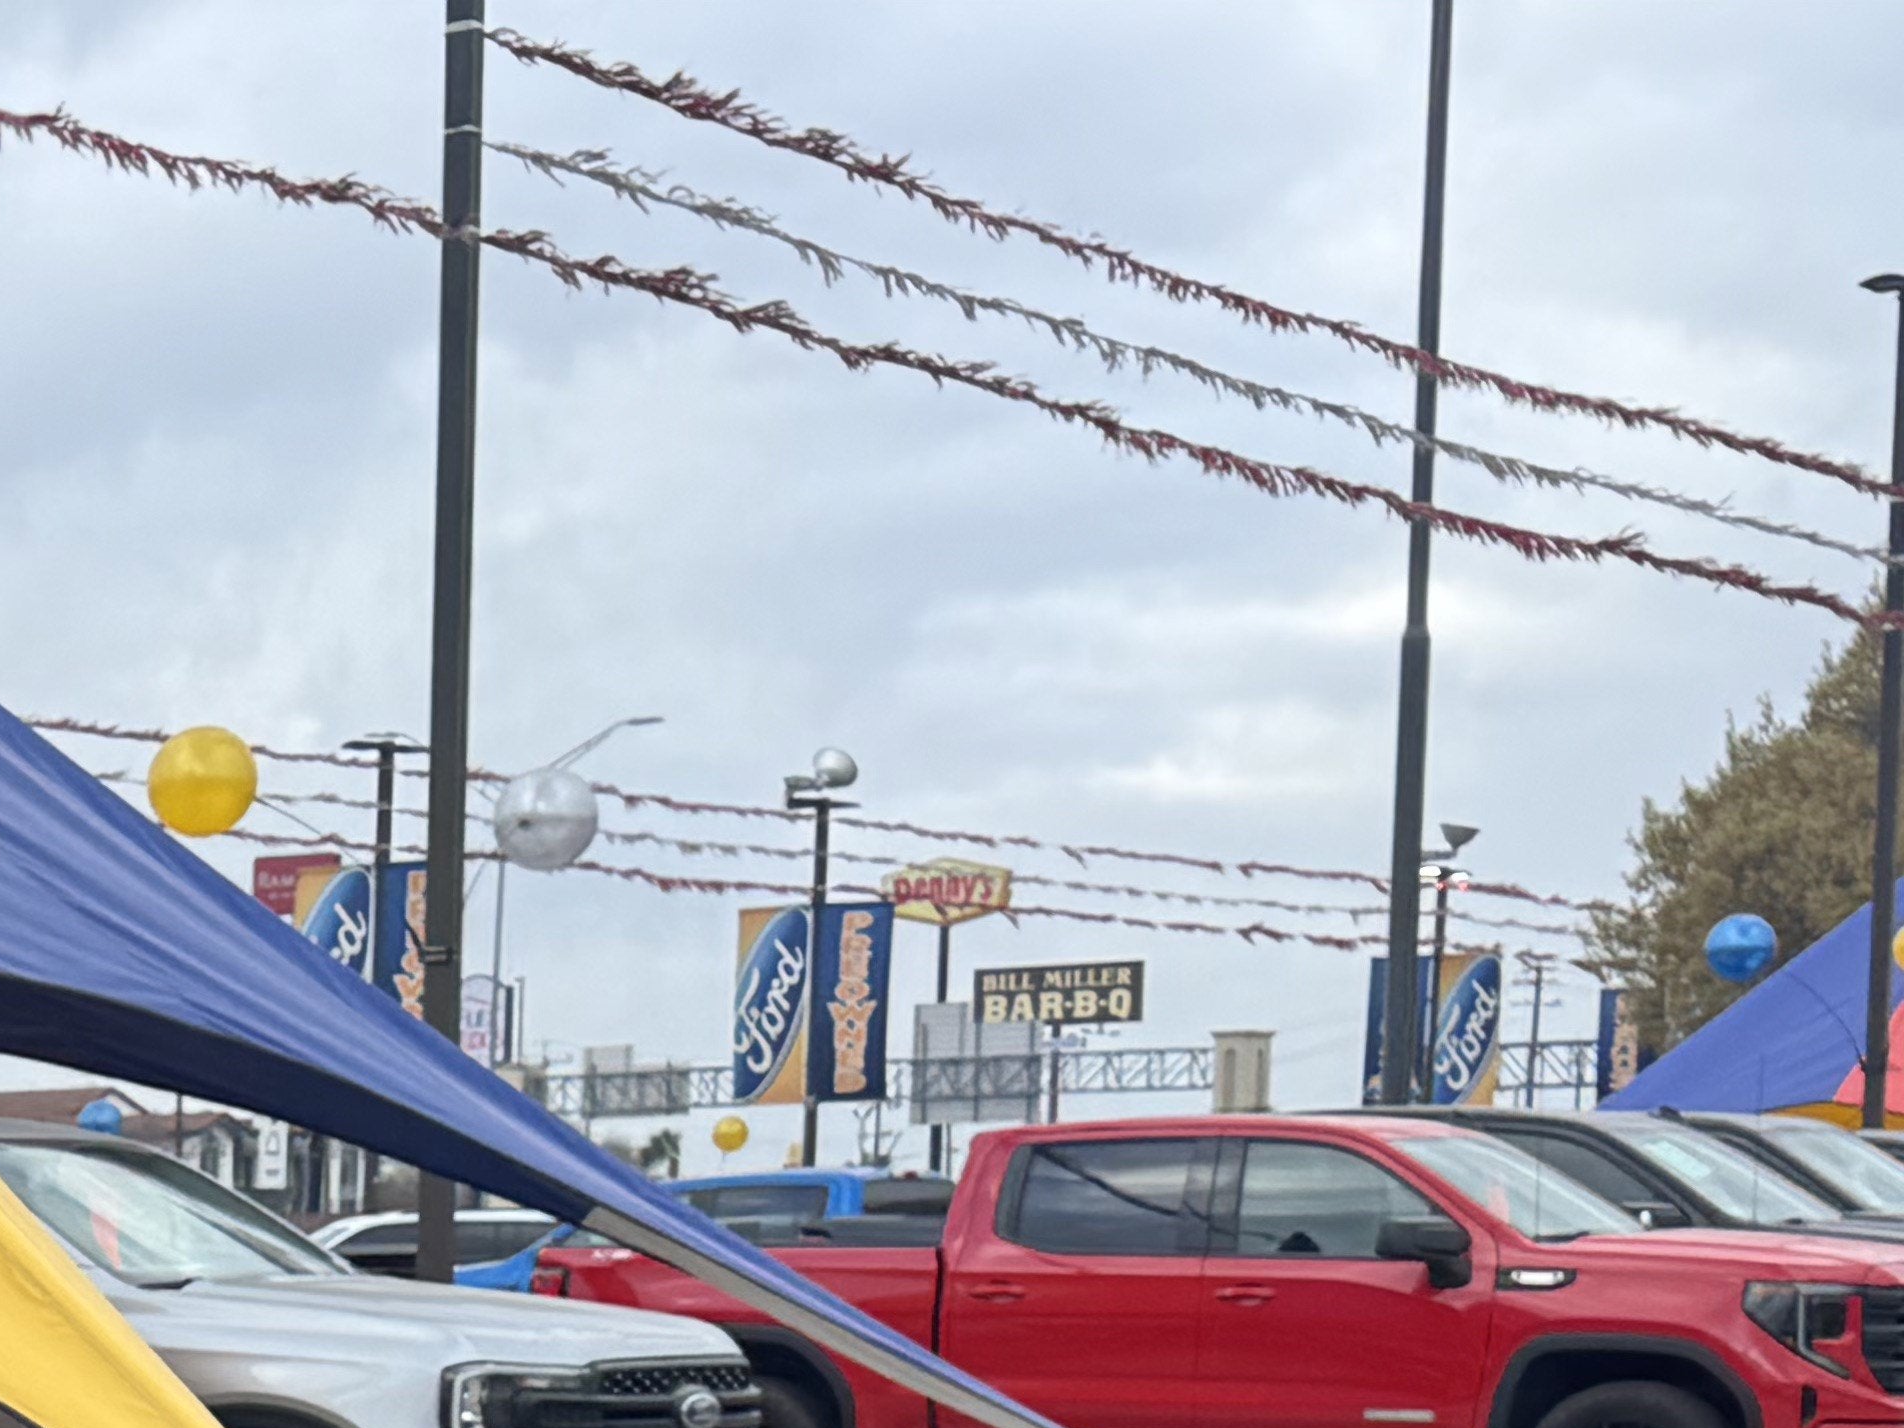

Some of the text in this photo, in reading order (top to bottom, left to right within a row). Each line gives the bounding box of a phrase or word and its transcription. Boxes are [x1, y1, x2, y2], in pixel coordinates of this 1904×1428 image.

[734, 938, 804, 1075] Ford
[982, 966, 1132, 993] BILL MILLER
[1434, 978, 1497, 1090] Ford
